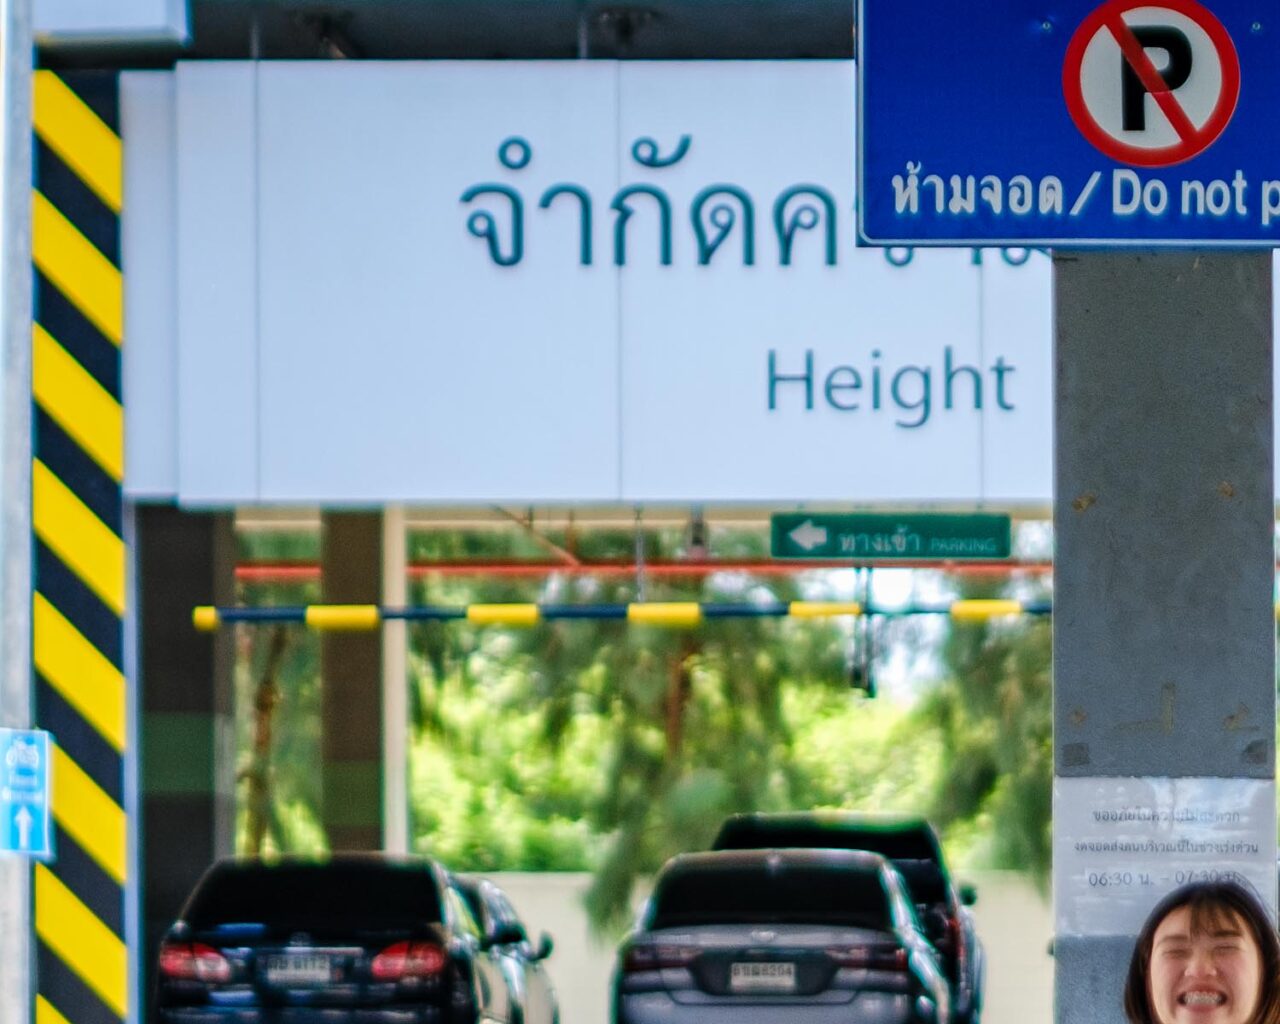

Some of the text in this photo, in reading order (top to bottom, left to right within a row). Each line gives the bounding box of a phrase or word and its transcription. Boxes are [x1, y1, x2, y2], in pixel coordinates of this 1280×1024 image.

[1121, 24, 1193, 131] P
[891, 161, 1063, 215] ห้ามจอด
[1112, 169, 1169, 216] Do
[1181, 169, 1248, 216] not
[767, 345, 1016, 428] Height
[837, 523, 998, 552] ทางเข้า PARKING
[1088, 871, 1133, 887] 06:30
